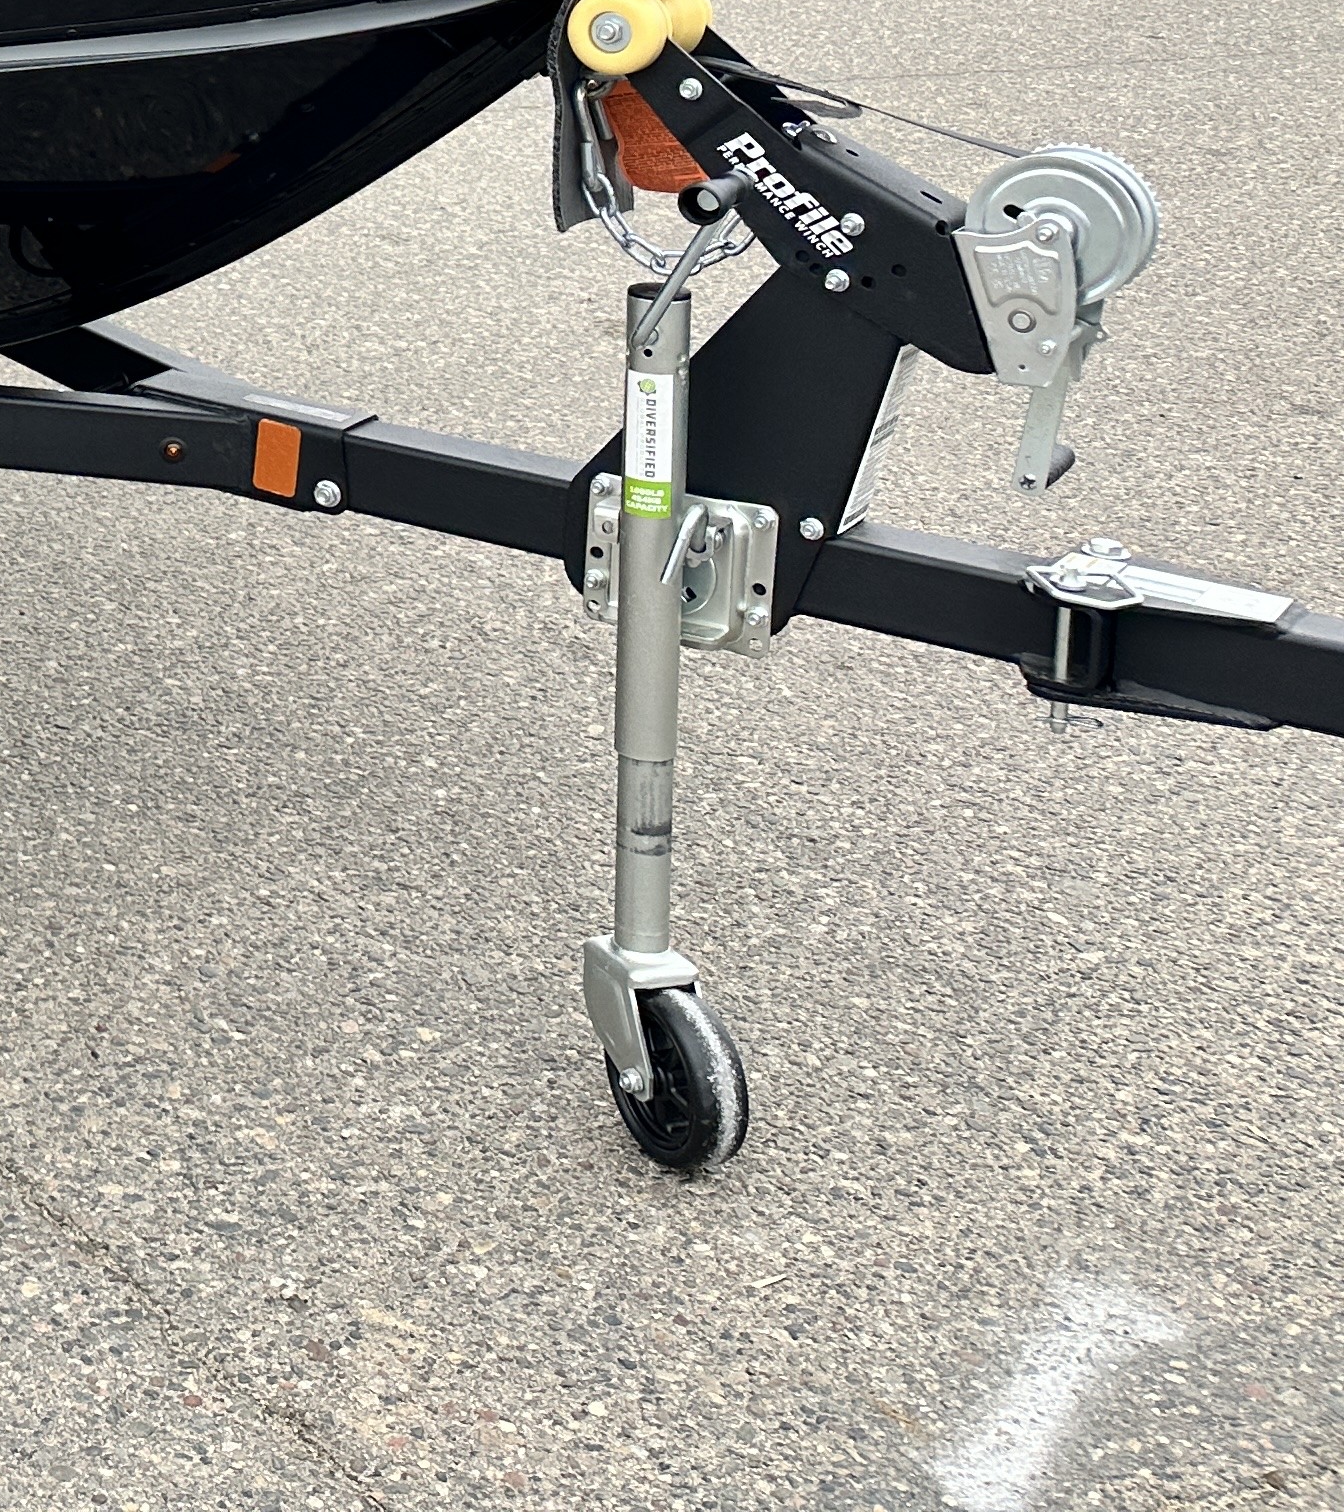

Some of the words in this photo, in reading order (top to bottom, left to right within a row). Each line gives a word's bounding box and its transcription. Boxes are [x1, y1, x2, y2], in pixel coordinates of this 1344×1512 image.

[716, 144, 796, 221] PERMANCE
[794, 218, 834, 259] WINCH
[723, 131, 854, 256] Profile
[645, 398, 657, 479] DIVERSIFIED
[625, 499, 669, 513] CAPACITY
